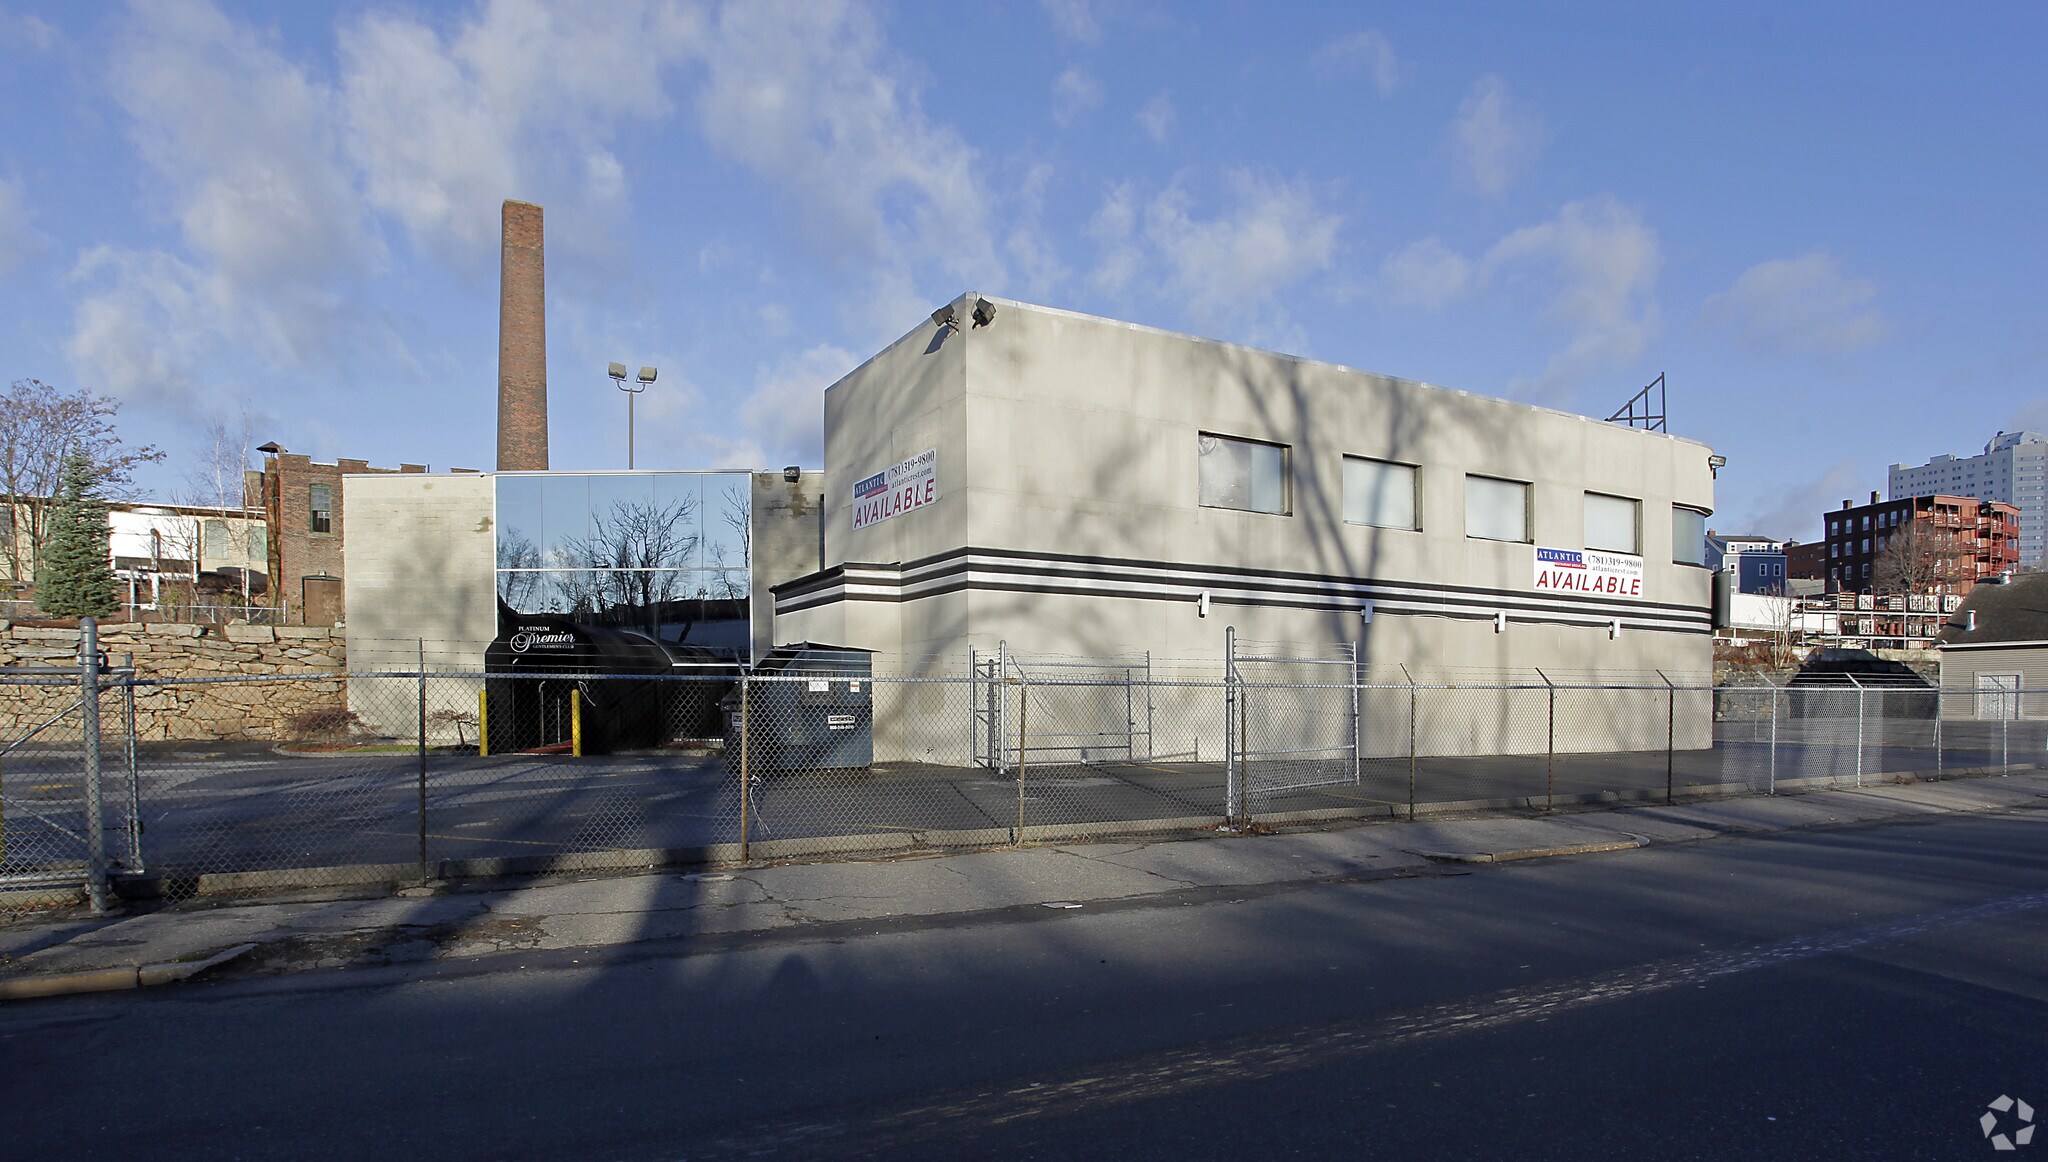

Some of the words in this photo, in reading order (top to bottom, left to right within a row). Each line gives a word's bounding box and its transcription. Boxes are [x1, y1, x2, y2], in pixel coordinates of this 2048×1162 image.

[888, 450, 935, 480] (781)319-9800
[855, 475, 884, 495] ATLANTIC
[891, 467, 932, 488] atlanticrest.com
[854, 478, 934, 528] AVAILABLE
[1538, 551, 1581, 562] ATLANTIC
[1588, 555, 1641, 568] (781)319-9800
[1592, 565, 1638, 575] atlanticrest.com
[1537, 570, 1640, 595] AVAILABLE
[511, 631, 576, 652] Premier
